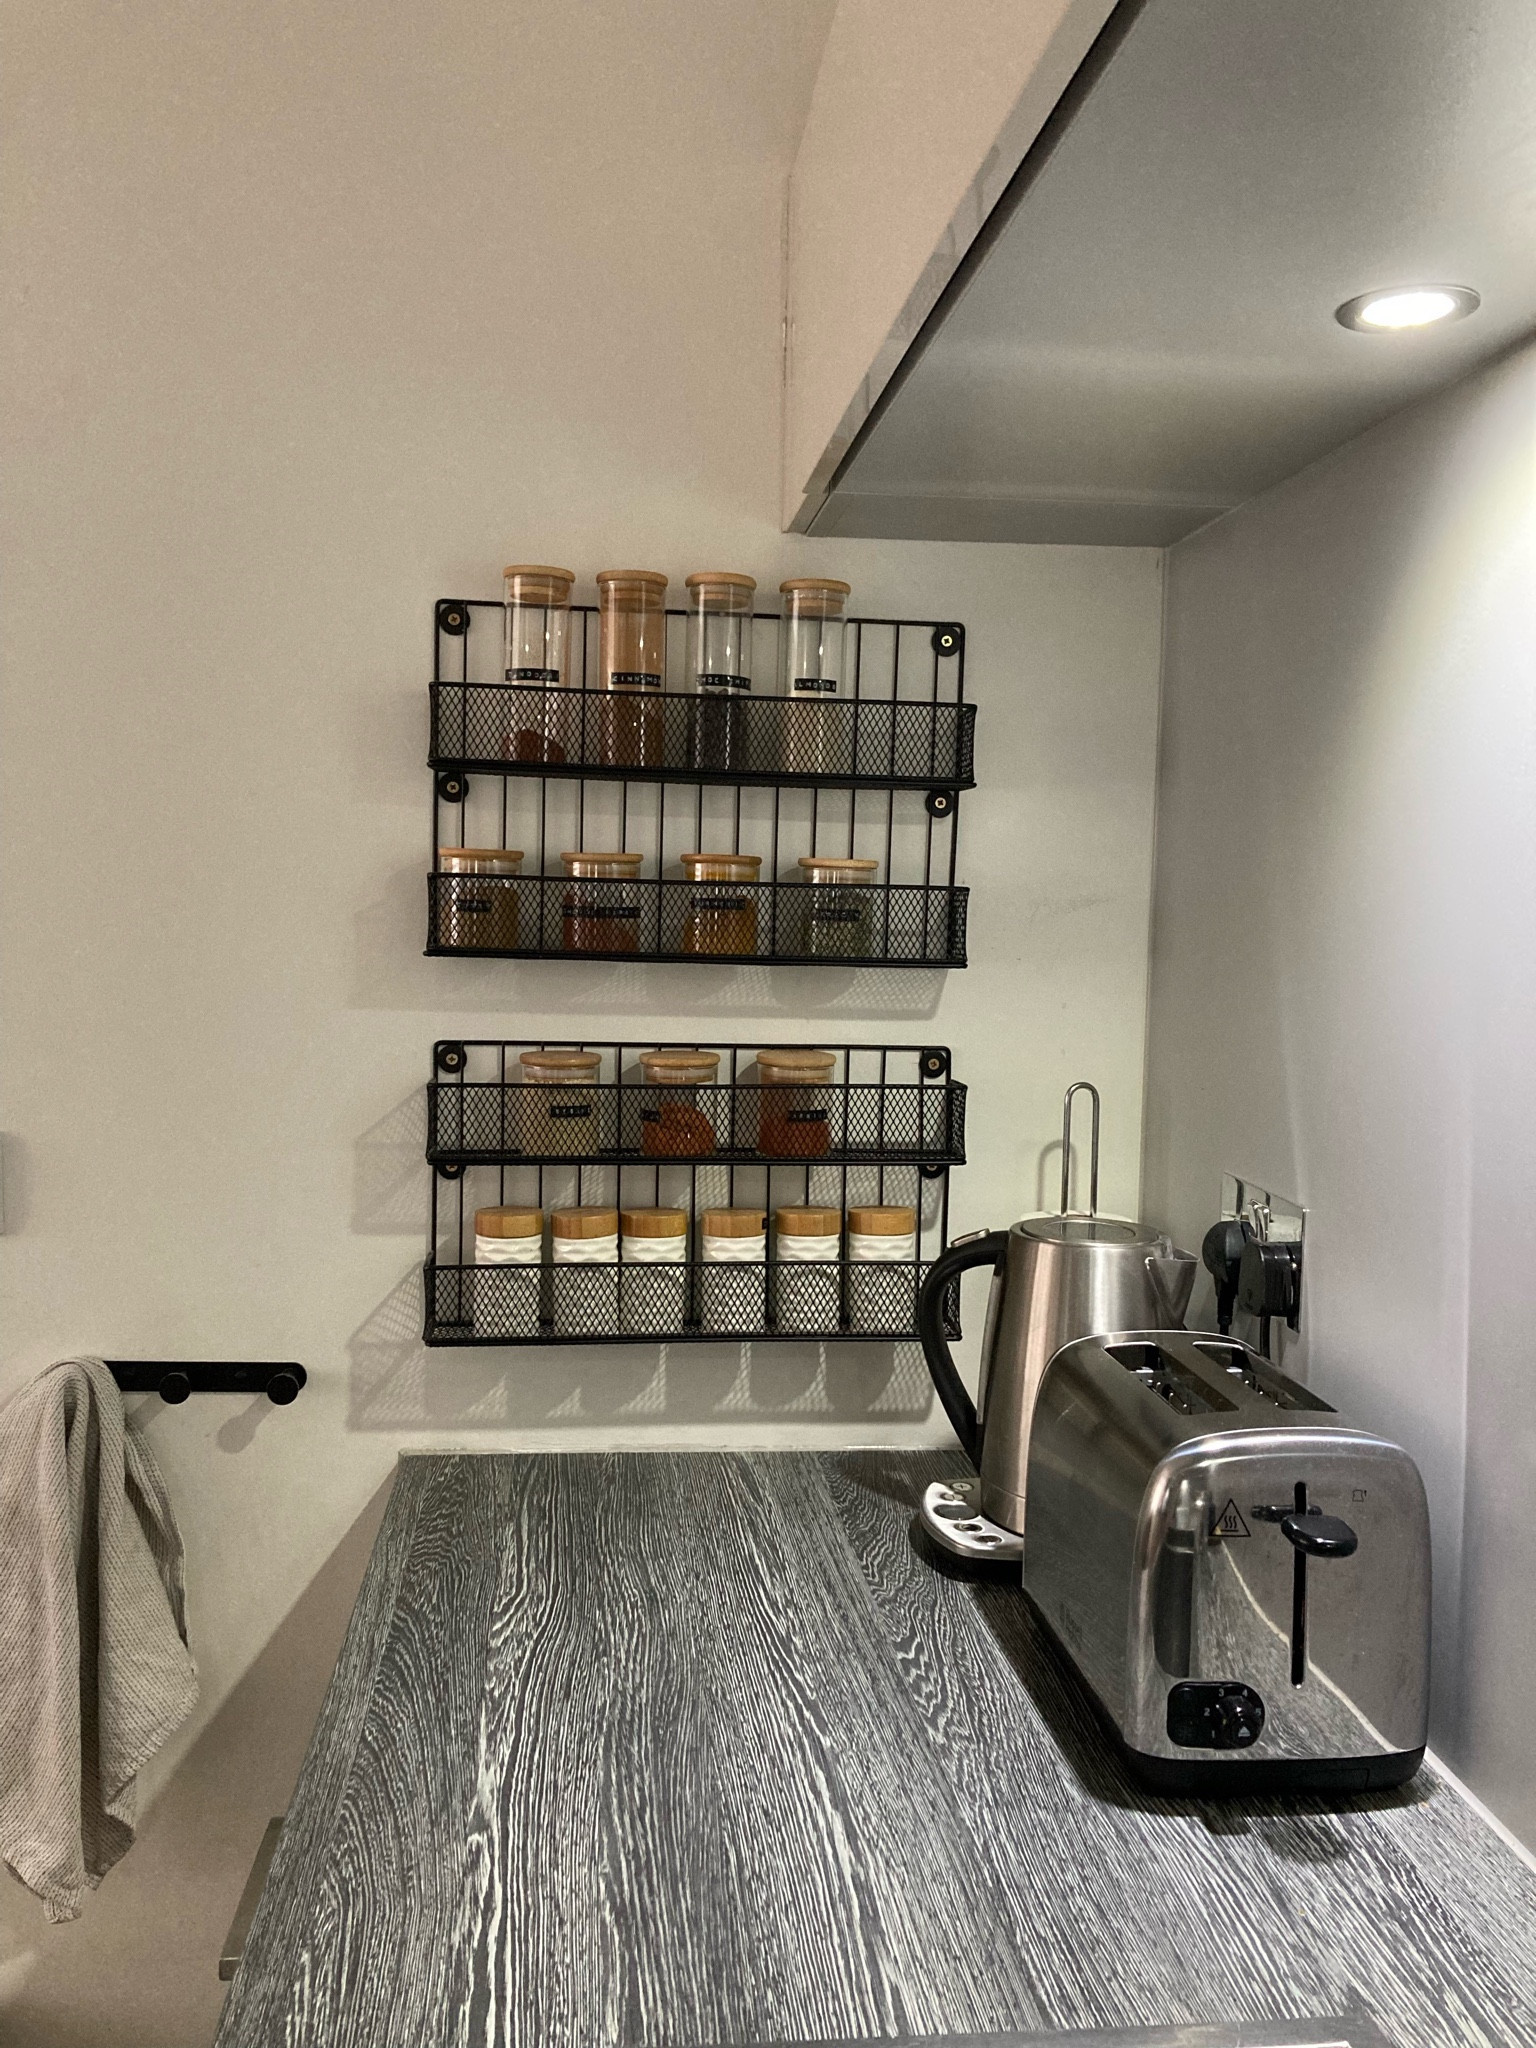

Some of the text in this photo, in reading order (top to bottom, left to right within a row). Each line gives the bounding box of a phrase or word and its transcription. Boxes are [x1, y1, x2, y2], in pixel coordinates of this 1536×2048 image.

[612, 674, 660, 686] CINNMO
[1218, 1688, 1225, 1697] 3
[1242, 1688, 1248, 1697] 4
[1203, 1707, 1210, 1717] 2
